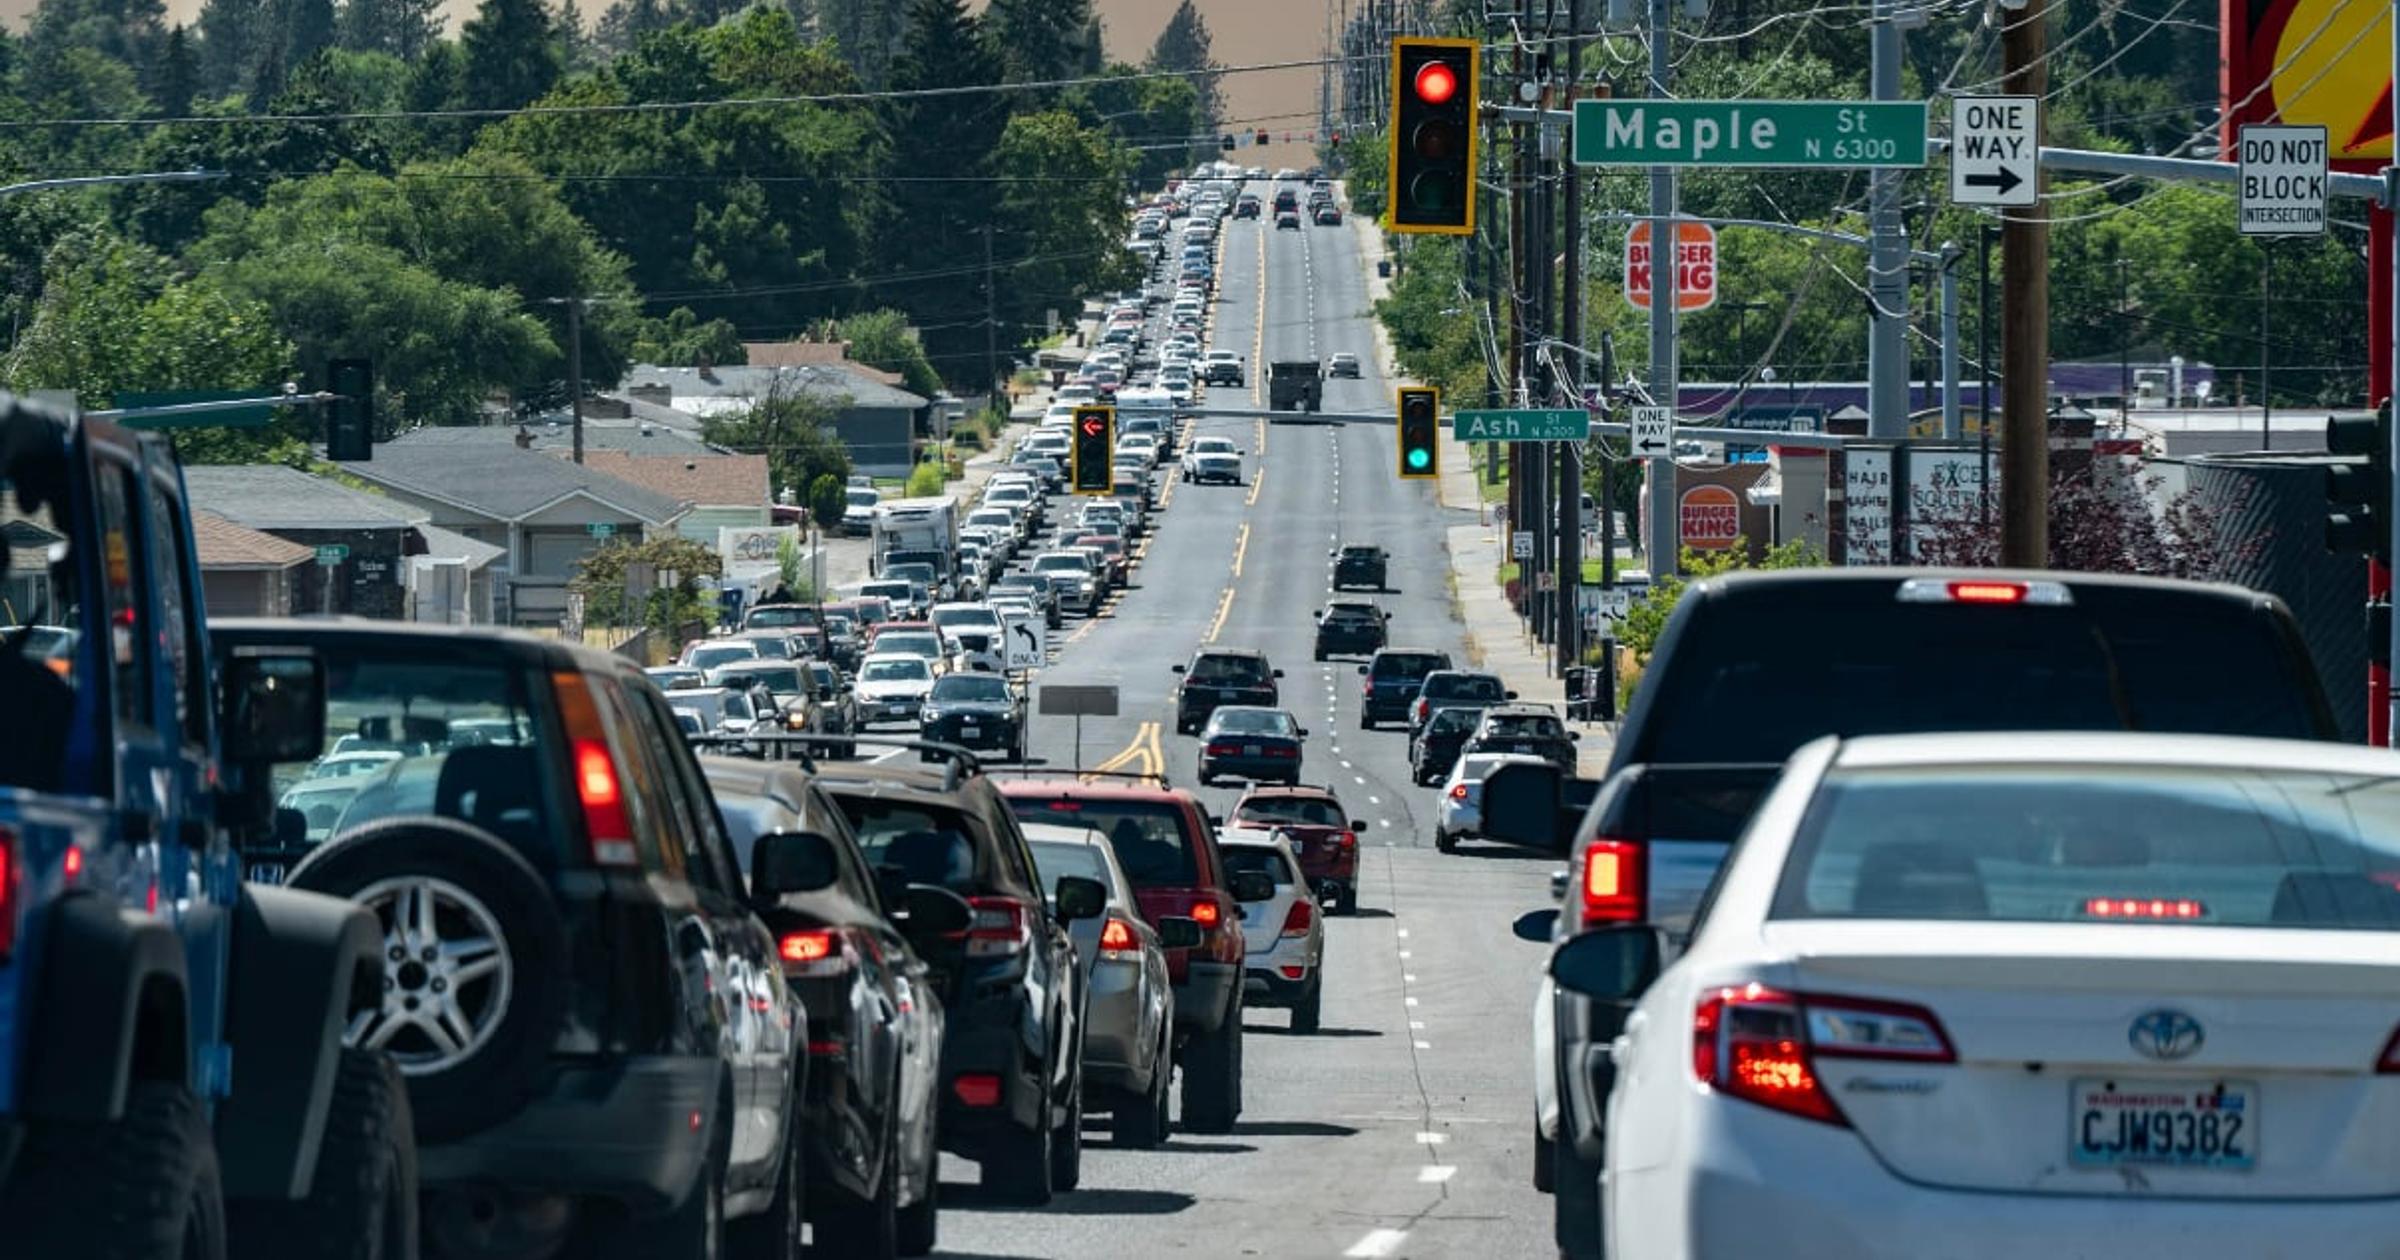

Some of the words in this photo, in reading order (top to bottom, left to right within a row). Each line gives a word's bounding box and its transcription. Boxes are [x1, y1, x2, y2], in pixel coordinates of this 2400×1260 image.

[1966, 106, 2024, 130] ONE
[1605, 107, 1778, 160] Maple
[1836, 109, 1868, 134] St
[1805, 139, 1821, 158] N
[1833, 139, 1897, 159] 6300
[1963, 135, 2024, 160] WAY
[2245, 140, 2275, 165] DO
[2281, 140, 2324, 165] NOT
[2244, 175, 2323, 200] BLOCK
[2243, 207, 2322, 223] INTERSECTION
[1630, 245, 1713, 263] BGER
[1630, 265, 1713, 290] KNG
[1468, 414, 1520, 437] Ash
[1545, 413, 1560, 424] St
[1637, 410, 1666, 422] ONE
[1531, 426, 1540, 437] N
[1637, 425, 1666, 436] WAY
[1848, 471, 1889, 486] HAIR
[1933, 460, 1985, 487] EXCE
[1681, 505, 1737, 519] BURGER
[1681, 519, 1737, 537] KING
[1848, 516, 1889, 529] NAILS
[1012, 653, 1041, 665] ONLY
[2082, 1110, 2245, 1158] CJW9382
